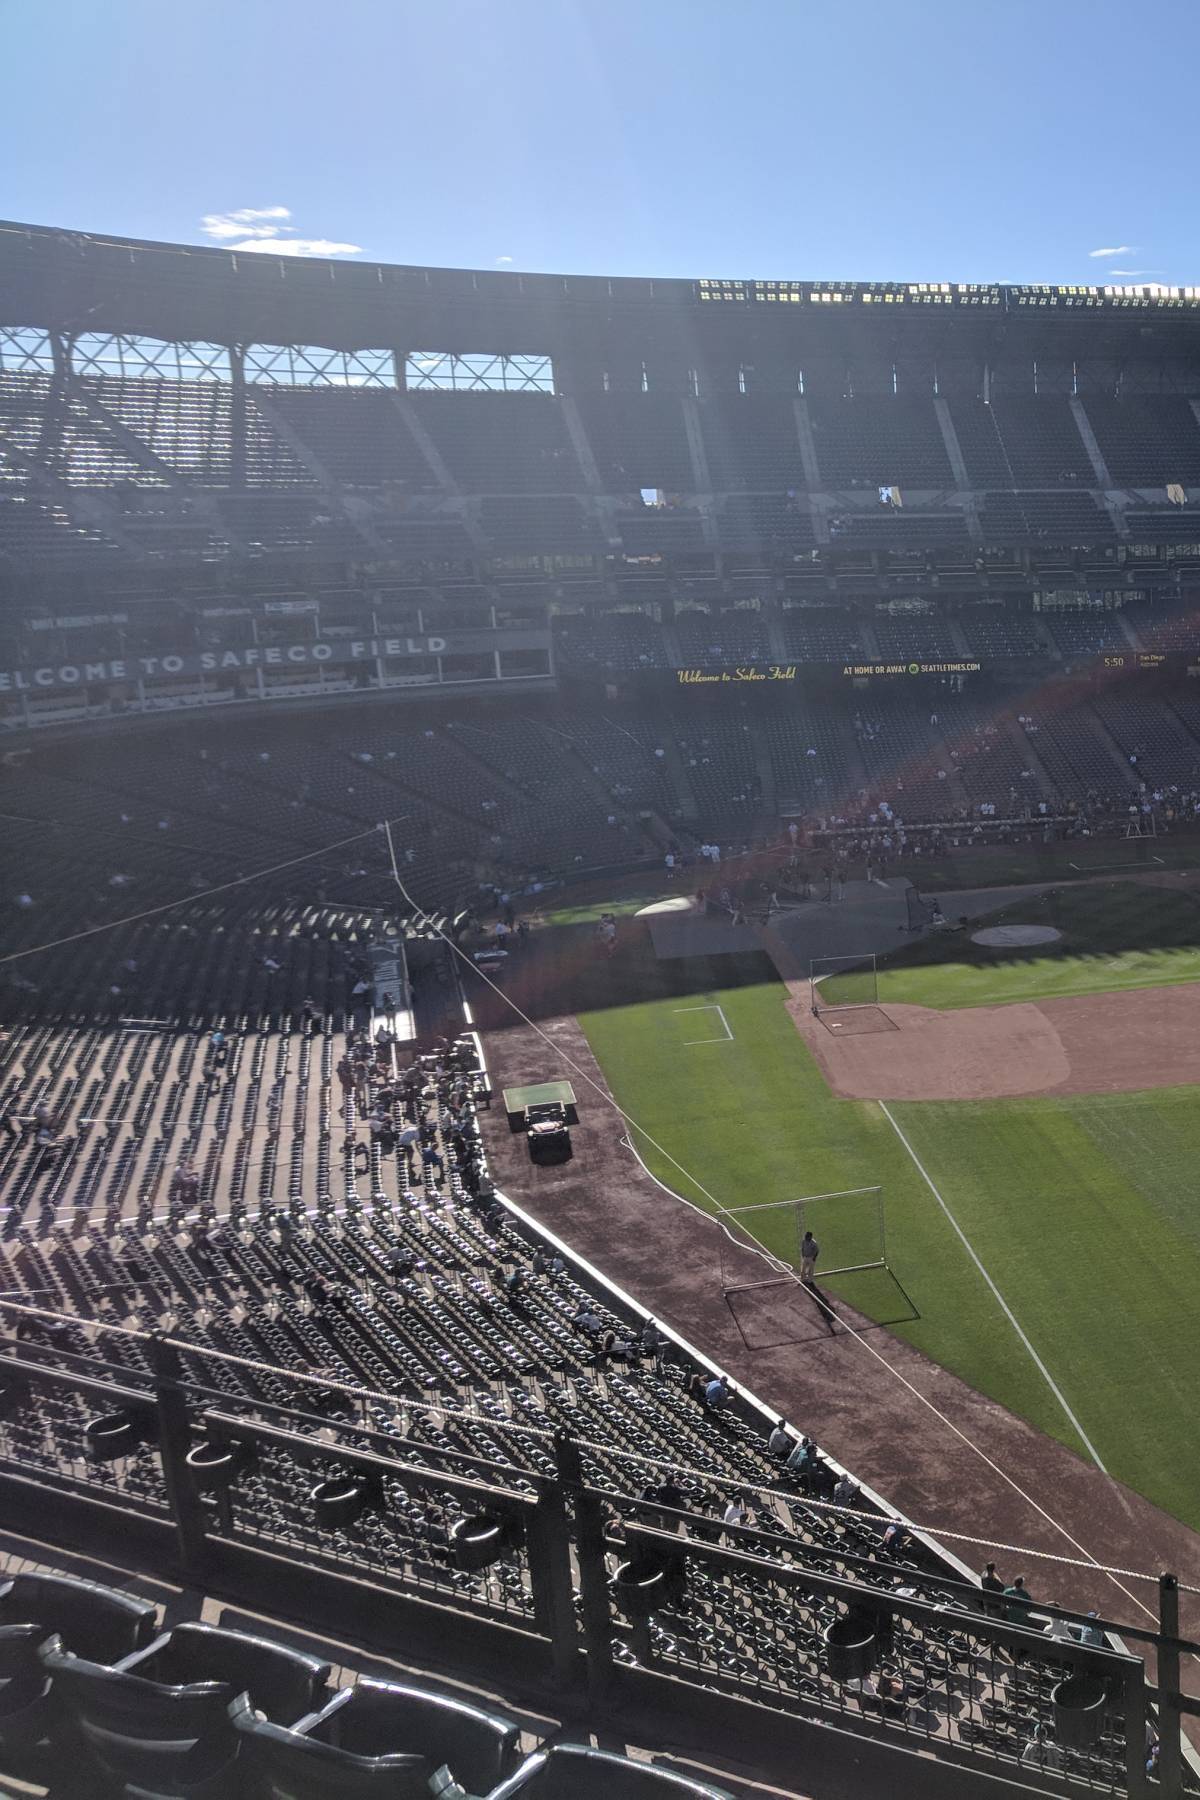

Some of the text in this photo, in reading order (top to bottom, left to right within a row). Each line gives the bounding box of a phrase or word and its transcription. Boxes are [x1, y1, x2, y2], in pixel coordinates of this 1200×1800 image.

[139, 655, 184, 674] TO
[200, 644, 332, 669] SAFECO
[351, 637, 447, 658] FIELD
[1104, 657, 1124, 667] 5:50
[677, 666, 797, 683] Welcome to Safeco Field
[854, 666, 874, 674] HOME
[886, 665, 906, 673] AWAY
[920, 663, 980, 672] SEATTLETIMES.COM
